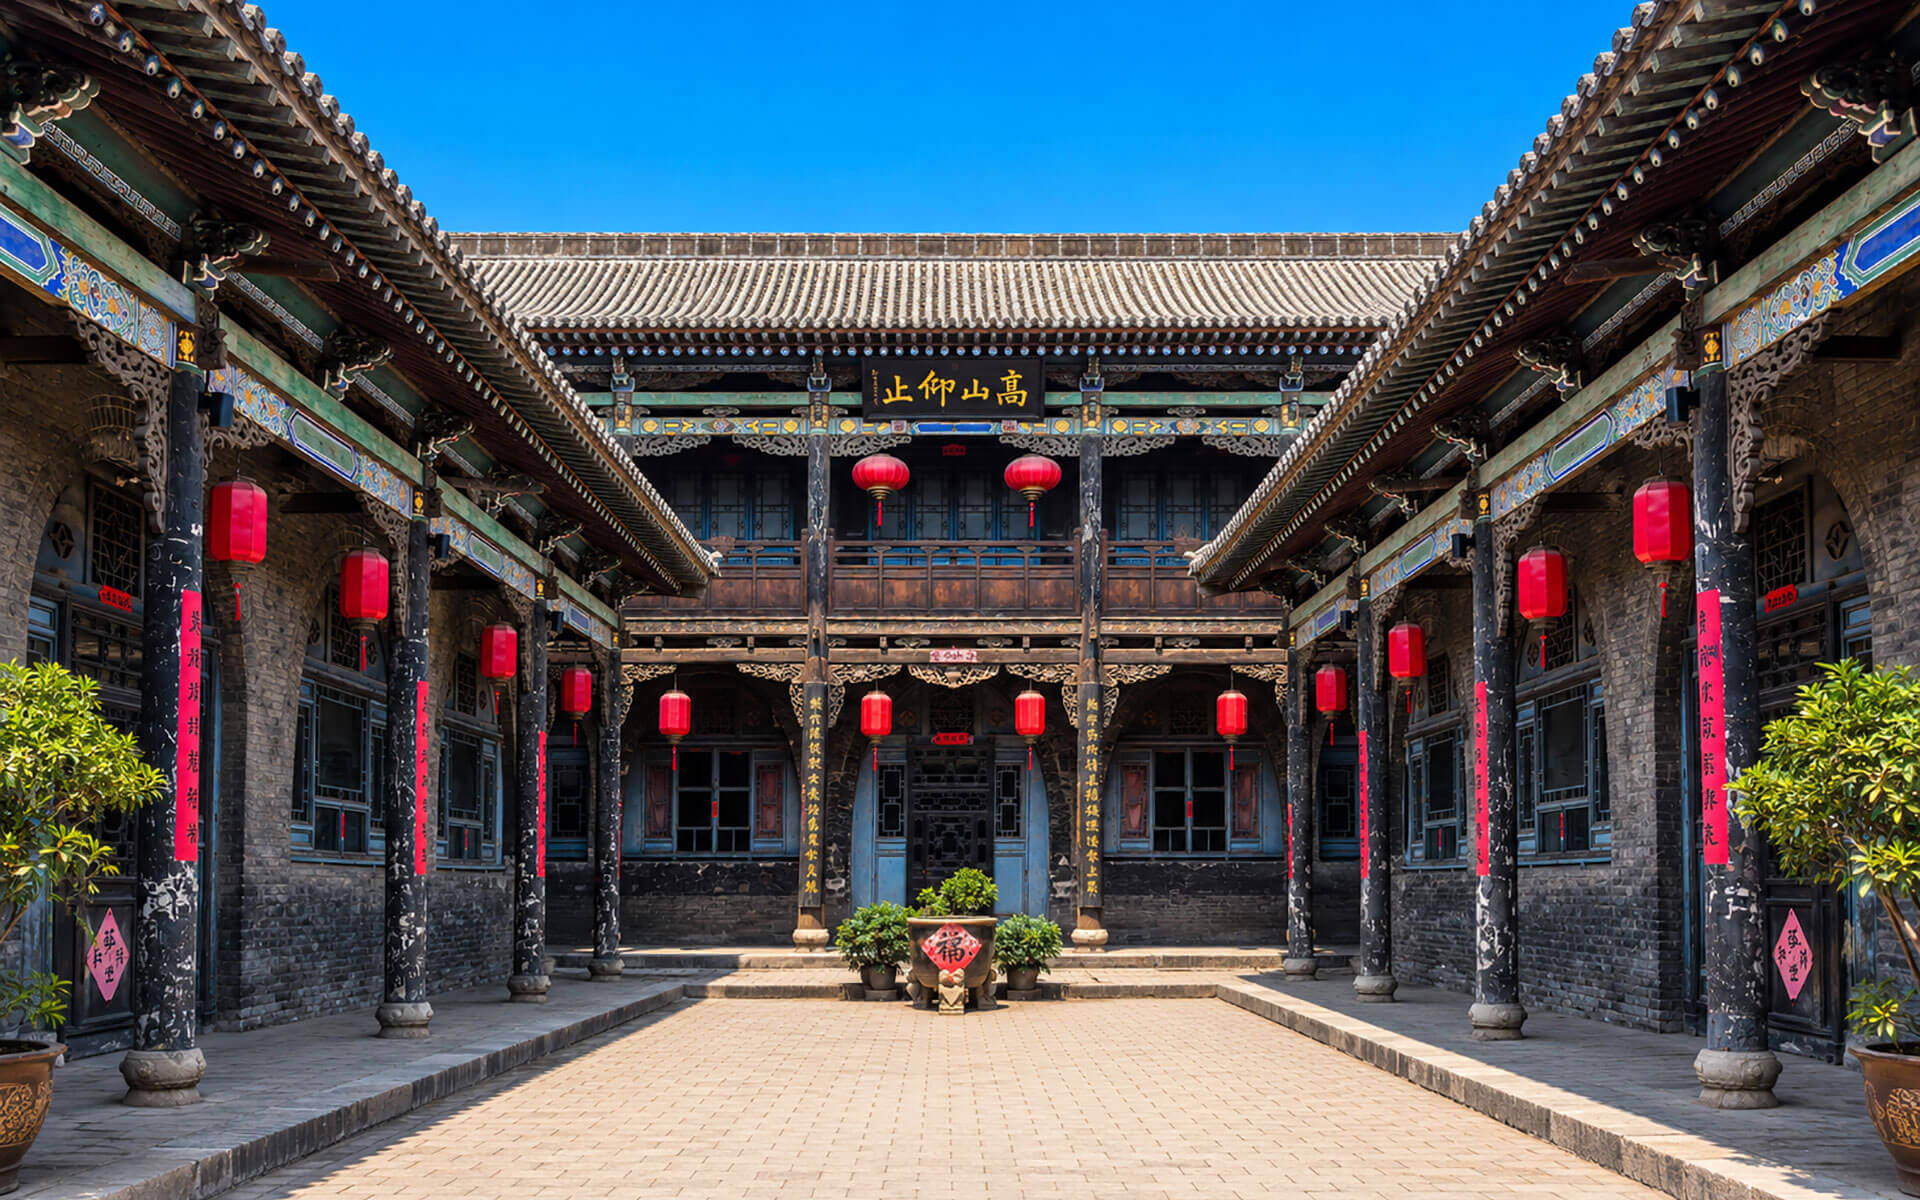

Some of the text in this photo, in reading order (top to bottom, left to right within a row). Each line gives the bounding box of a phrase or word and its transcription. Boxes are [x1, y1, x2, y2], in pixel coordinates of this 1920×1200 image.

[882, 369, 1028, 408] 高山仰止
[936, 932, 965, 963] 福
